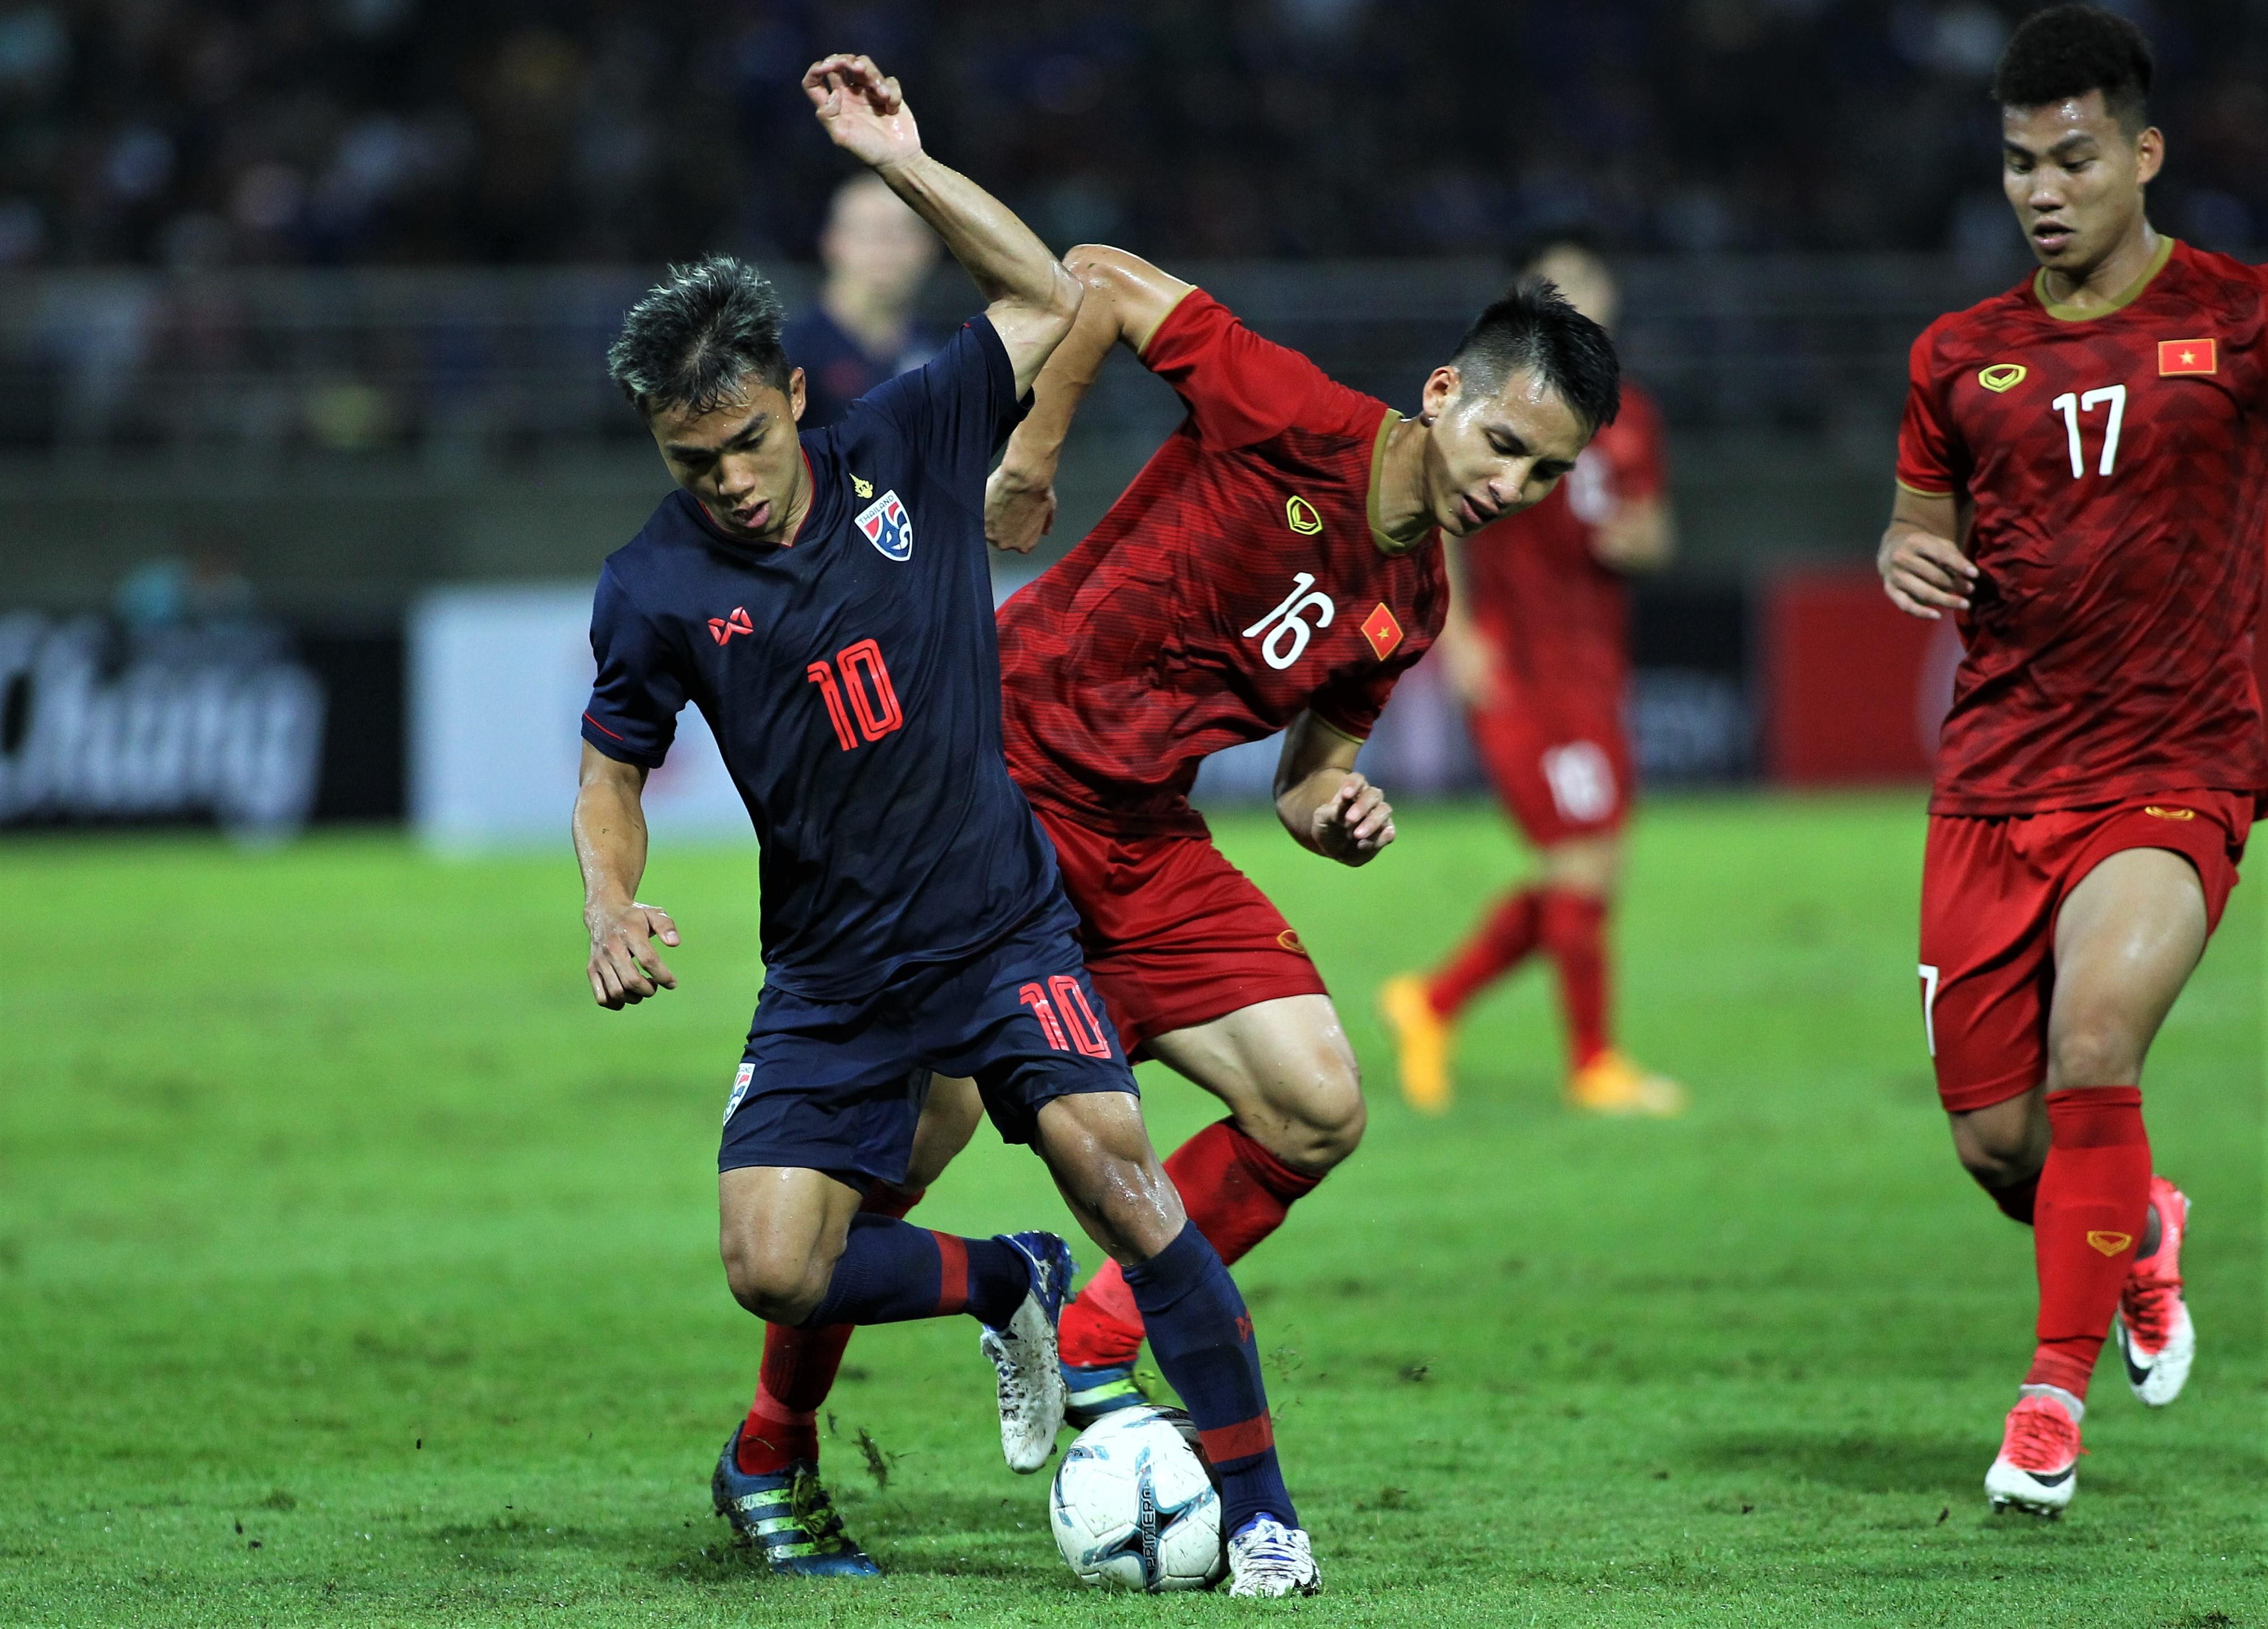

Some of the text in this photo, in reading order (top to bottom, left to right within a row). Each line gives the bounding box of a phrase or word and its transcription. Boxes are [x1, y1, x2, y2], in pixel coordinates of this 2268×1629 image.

[2053, 384, 2126, 479] 17
[859, 494, 894, 524] THAILAND
[1242, 572, 1335, 669] 16
[807, 638, 903, 752] 10
[1020, 975, 1112, 1059] 10
[1141, 1486, 1156, 1570] PRIMERA
